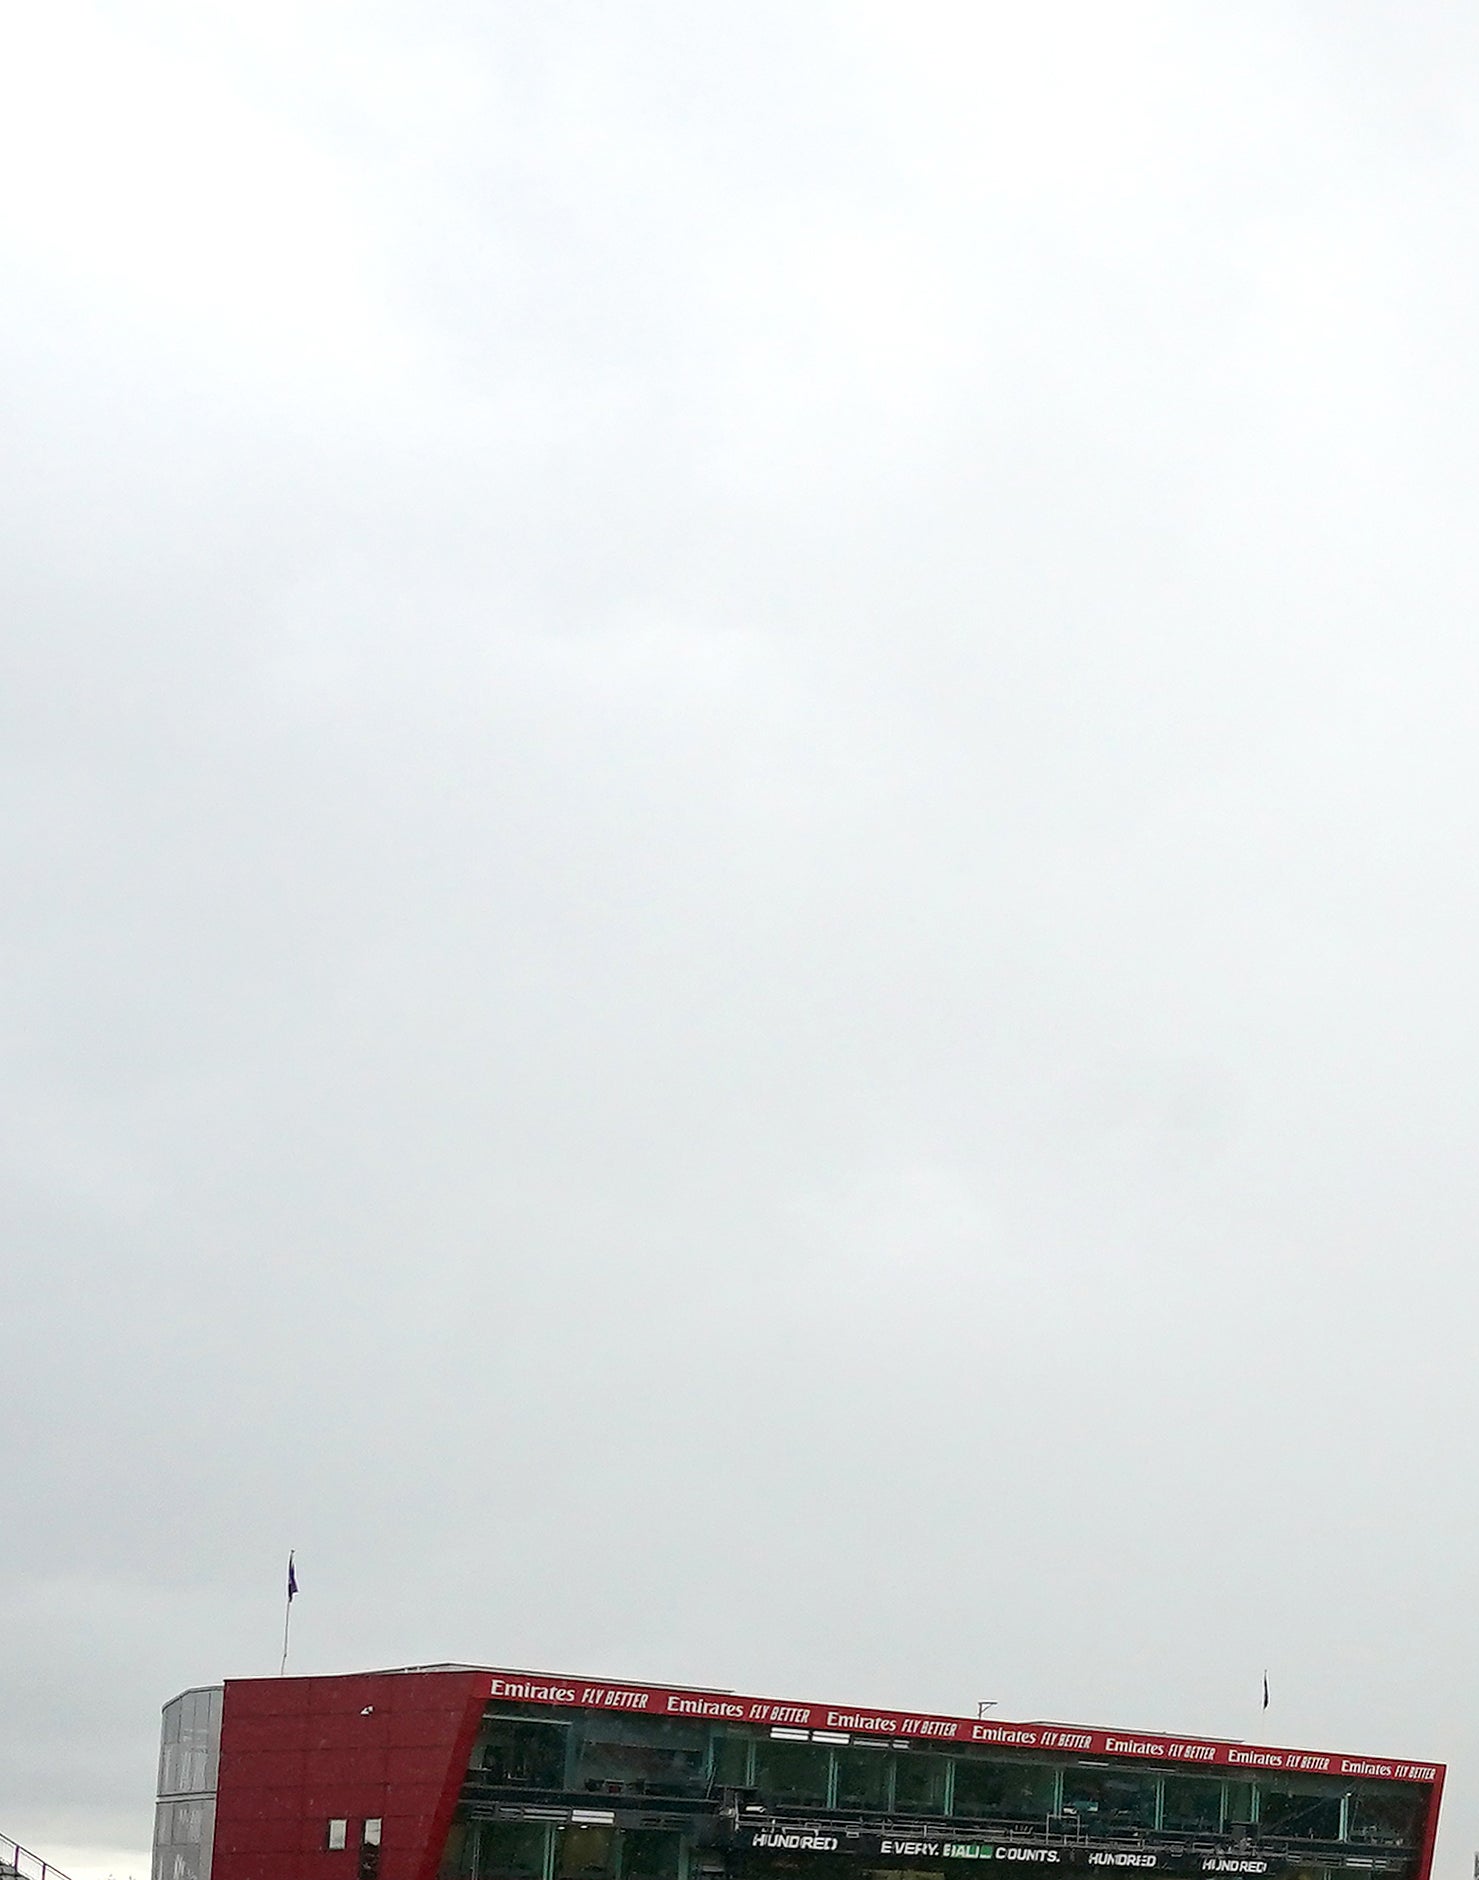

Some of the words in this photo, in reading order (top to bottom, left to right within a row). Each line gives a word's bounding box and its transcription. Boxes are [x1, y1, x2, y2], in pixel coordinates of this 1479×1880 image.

[491, 1679, 575, 1702] Emirates
[581, 1688, 603, 1705] FLY
[605, 1690, 650, 1709] BETTER
[667, 1696, 744, 1717] Emirates
[750, 1704, 770, 1720] FLY
[770, 1707, 811, 1724] BETTER
[826, 1711, 897, 1733] Emirates
[901, 1718, 920, 1734] FLY
[920, 1721, 958, 1737] BETTER
[972, 1725, 1037, 1745] Emirates
[1040, 1731, 1058, 1746] FLY
[1058, 1733, 1093, 1750] BETTER
[1105, 1737, 1164, 1756] Emirates
[1167, 1743, 1184, 1758] FLY
[1184, 1745, 1216, 1760] BETTER
[1228, 1749, 1283, 1766] Emirates
[1285, 1754, 1301, 1767] FLY
[1300, 1756, 1330, 1770] BETTER
[1341, 1759, 1392, 1777] Emirates
[1394, 1764, 1410, 1777] FLY
[1409, 1766, 1436, 1781] BETTER
[753, 1834, 839, 1851] HUNDRED
[880, 1841, 940, 1857] EVERY.
[995, 1847, 1061, 1864] COUNTS.
[1088, 1852, 1157, 1868] HUNDRED
[1202, 1858, 1267, 1874] HUNDRED
